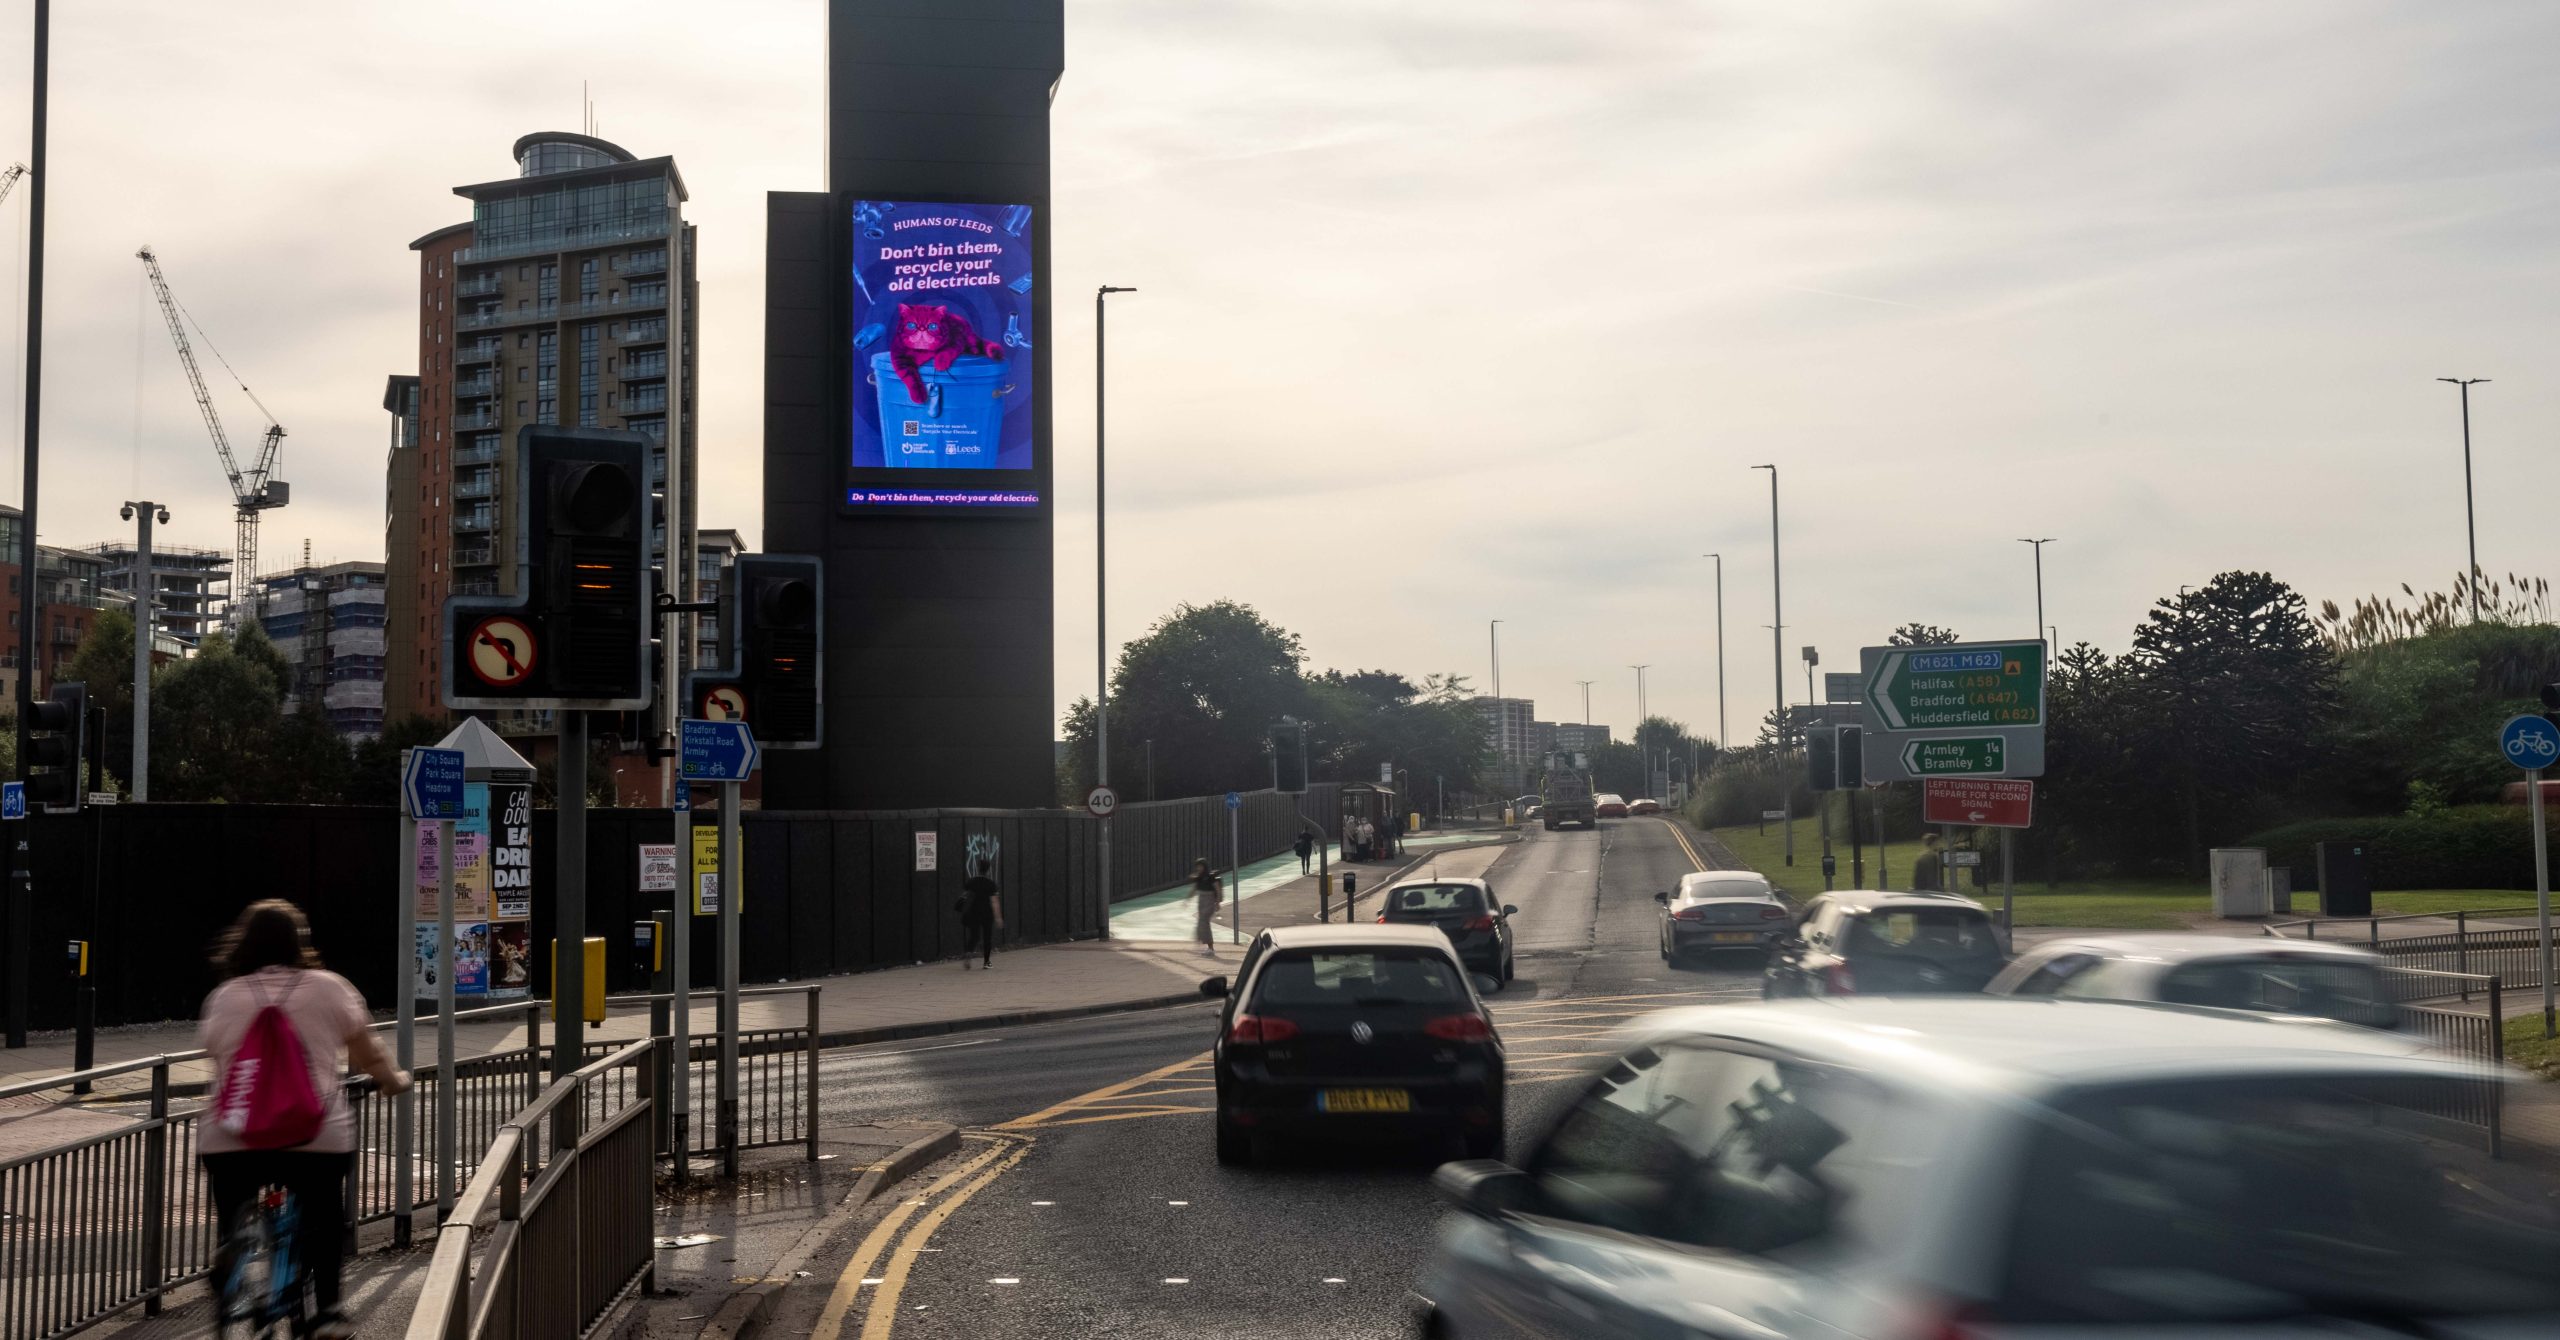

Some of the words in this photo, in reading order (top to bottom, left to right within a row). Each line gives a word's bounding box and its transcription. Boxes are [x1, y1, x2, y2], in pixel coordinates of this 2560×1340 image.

[894, 217, 941, 231] HUMANS
[944, 218, 958, 227] OF
[959, 220, 993, 234] LEEDS
[928, 244, 954, 256] bin
[957, 242, 1002, 255] them,
[895, 260, 953, 276] recycle
[955, 258, 992, 273] your
[888, 278, 913, 291] old
[917, 272, 1000, 290] electricals
[894, 493, 908, 501] bin
[909, 494, 933, 503] them,
[935, 494, 966, 503] recycle
[967, 495, 987, 503] your
[1911, 679, 1955, 690] Halifax
[1911, 695, 1964, 707] Bradford
[1911, 710, 1990, 724] Huddersfield
[684, 725, 716, 734] Bradford
[685, 736, 714, 745] Kirkstall
[716, 737, 734, 746] Road
[685, 747, 710, 757] Armley
[1924, 744, 1965, 756] Armley
[426, 753, 437, 765] City
[440, 754, 460, 766] Square
[1925, 758, 1973, 769] Bramley
[1984, 756, 1992, 767] 3
[425, 768, 439, 779] Park
[441, 770, 461, 780] Square
[425, 783, 451, 793] Headrow
[1950, 782, 1990, 790] TURNING
[1993, 784, 2028, 792] TRAFFIC
[1091, 795, 1112, 807] 40
[1929, 790, 1967, 798] PREPARE
[1990, 792, 2027, 801] SECOND
[1961, 800, 1993, 808] SIGNAL
[464, 808, 479, 818] IALS
[508, 827, 528, 845] EA
[496, 847, 530, 866] DRI
